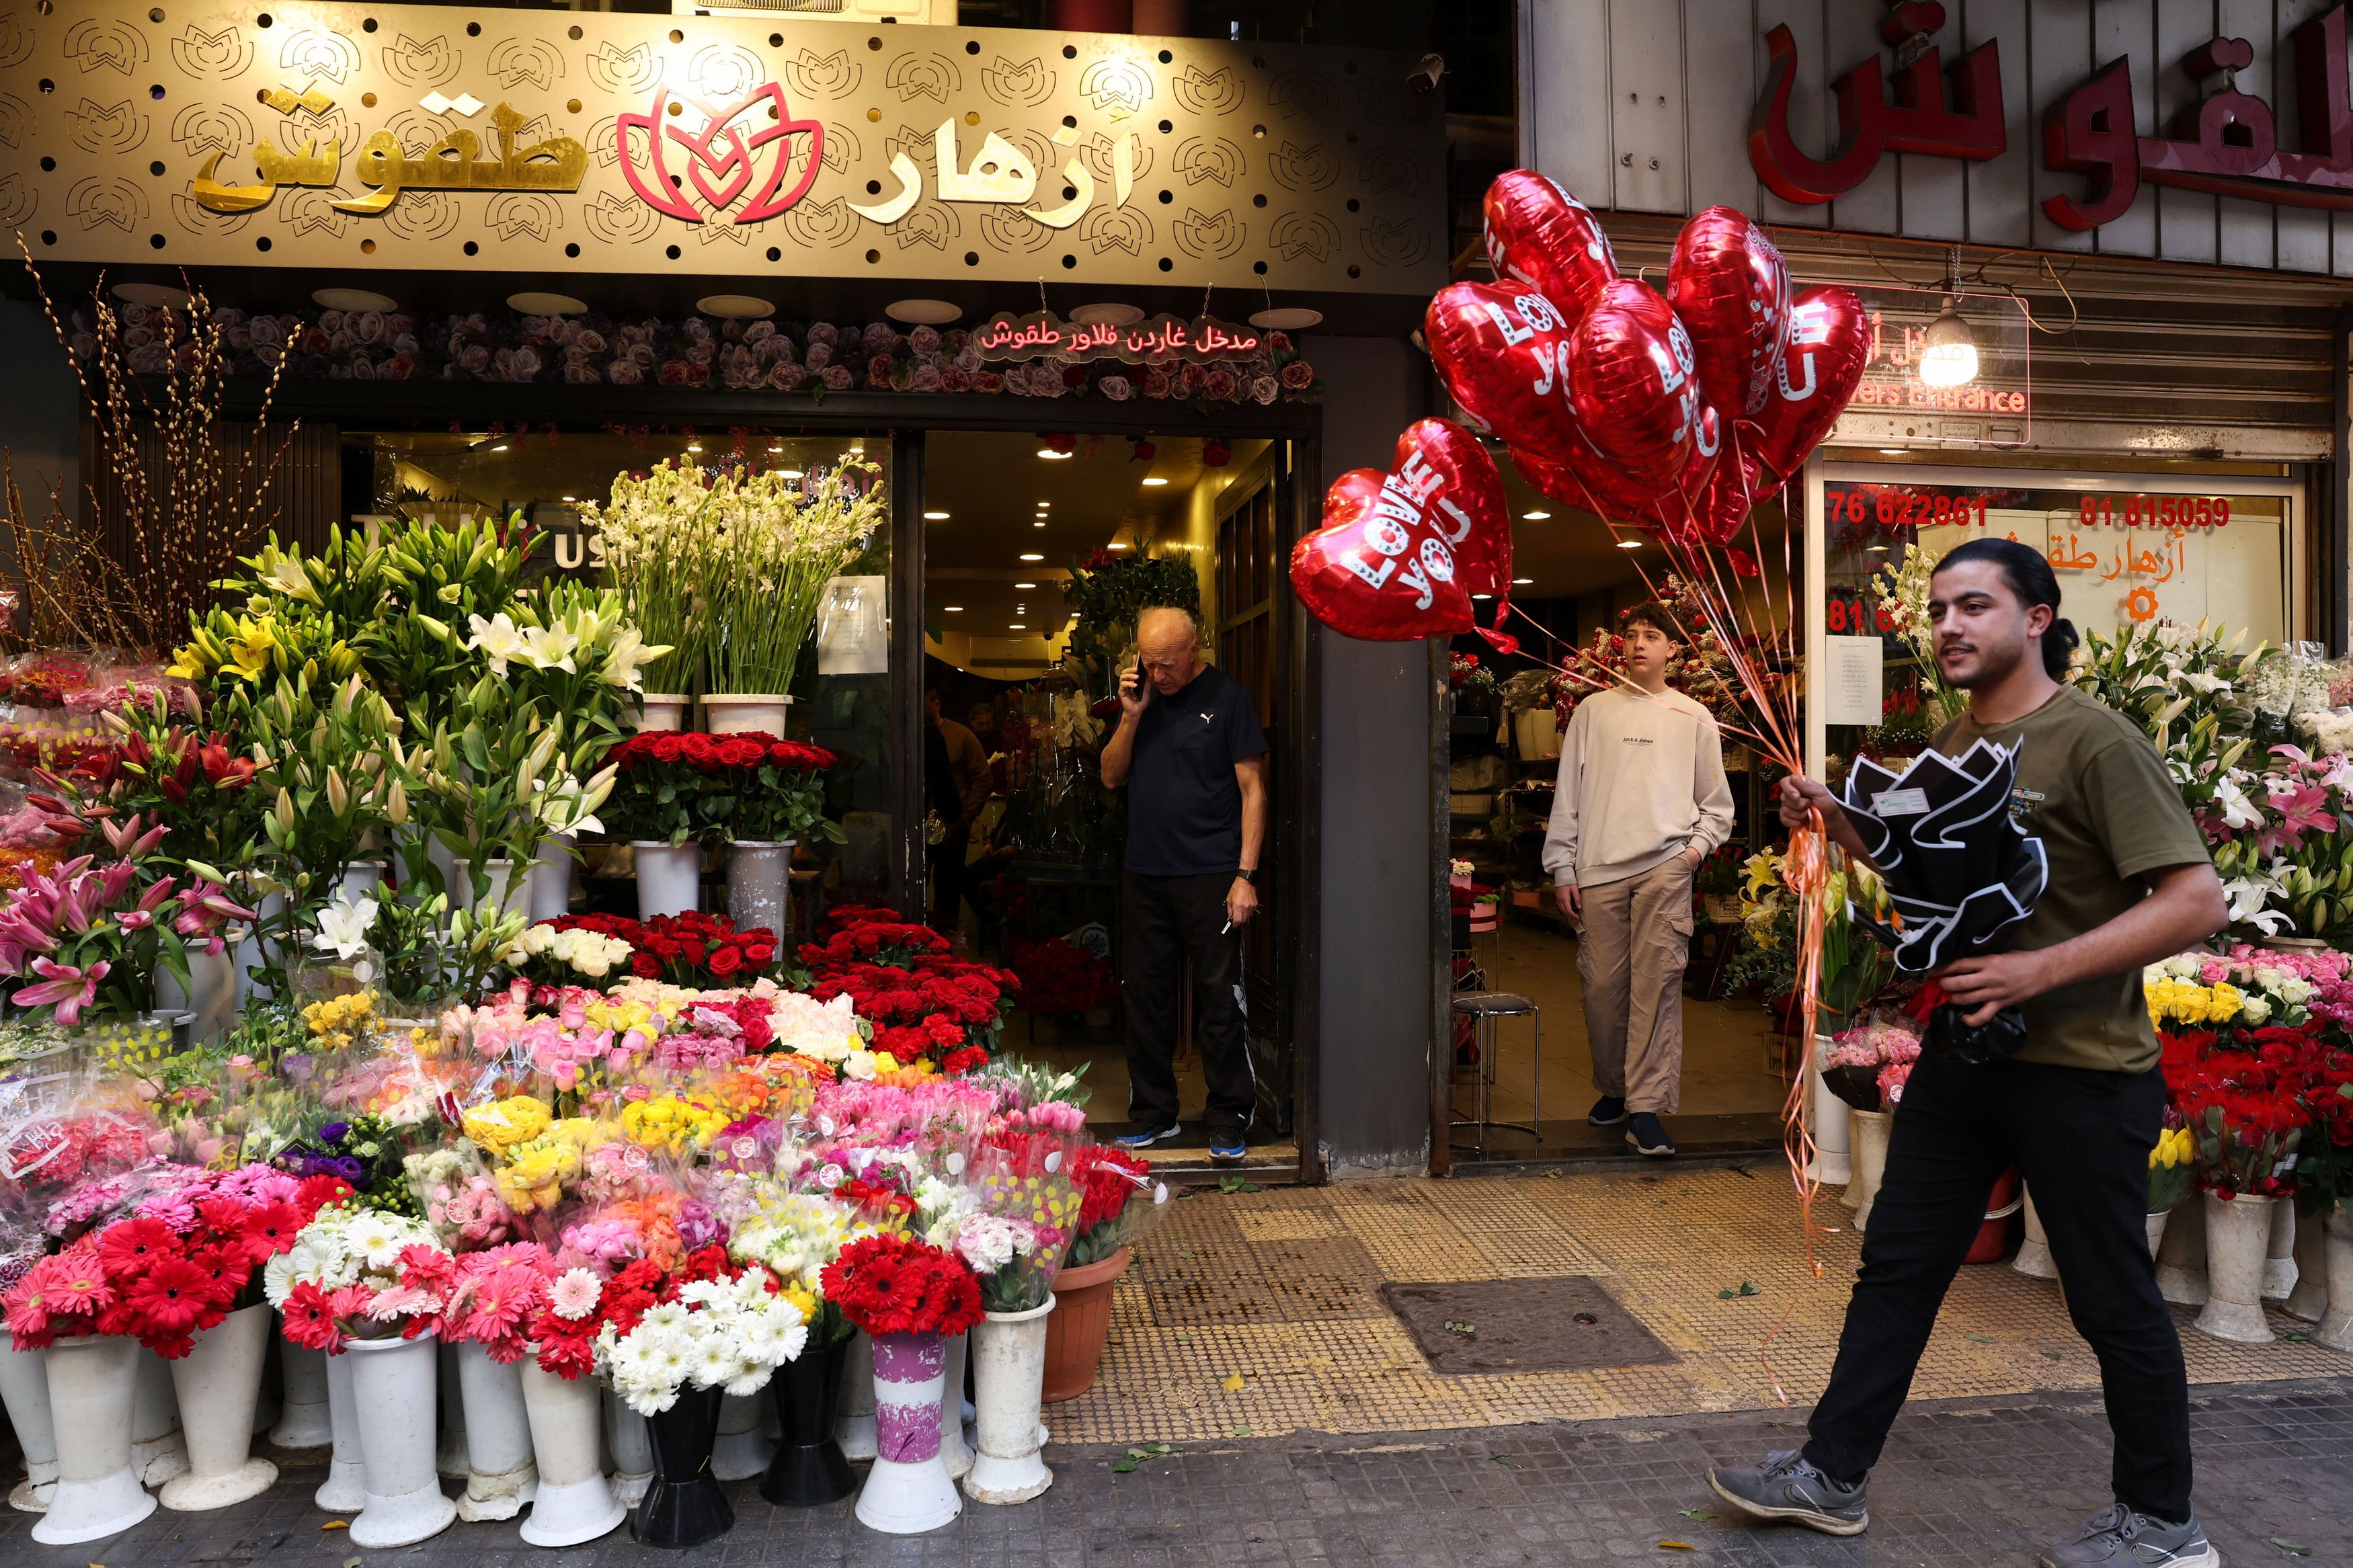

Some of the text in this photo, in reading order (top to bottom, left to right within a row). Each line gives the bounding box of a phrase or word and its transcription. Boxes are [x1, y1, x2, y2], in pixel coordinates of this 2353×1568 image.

[194, 74, 590, 214] طقوش
[981, 321, 1257, 354] مدخل غاردن فلاور طقوش
[1909, 376, 2026, 413] Entrance
[1827, 491, 1987, 527] 76 622861
[2080, 497, 2230, 527] 81 815059
[2100, 526, 2186, 583] أزهار
[1829, 600, 1862, 632] 81
